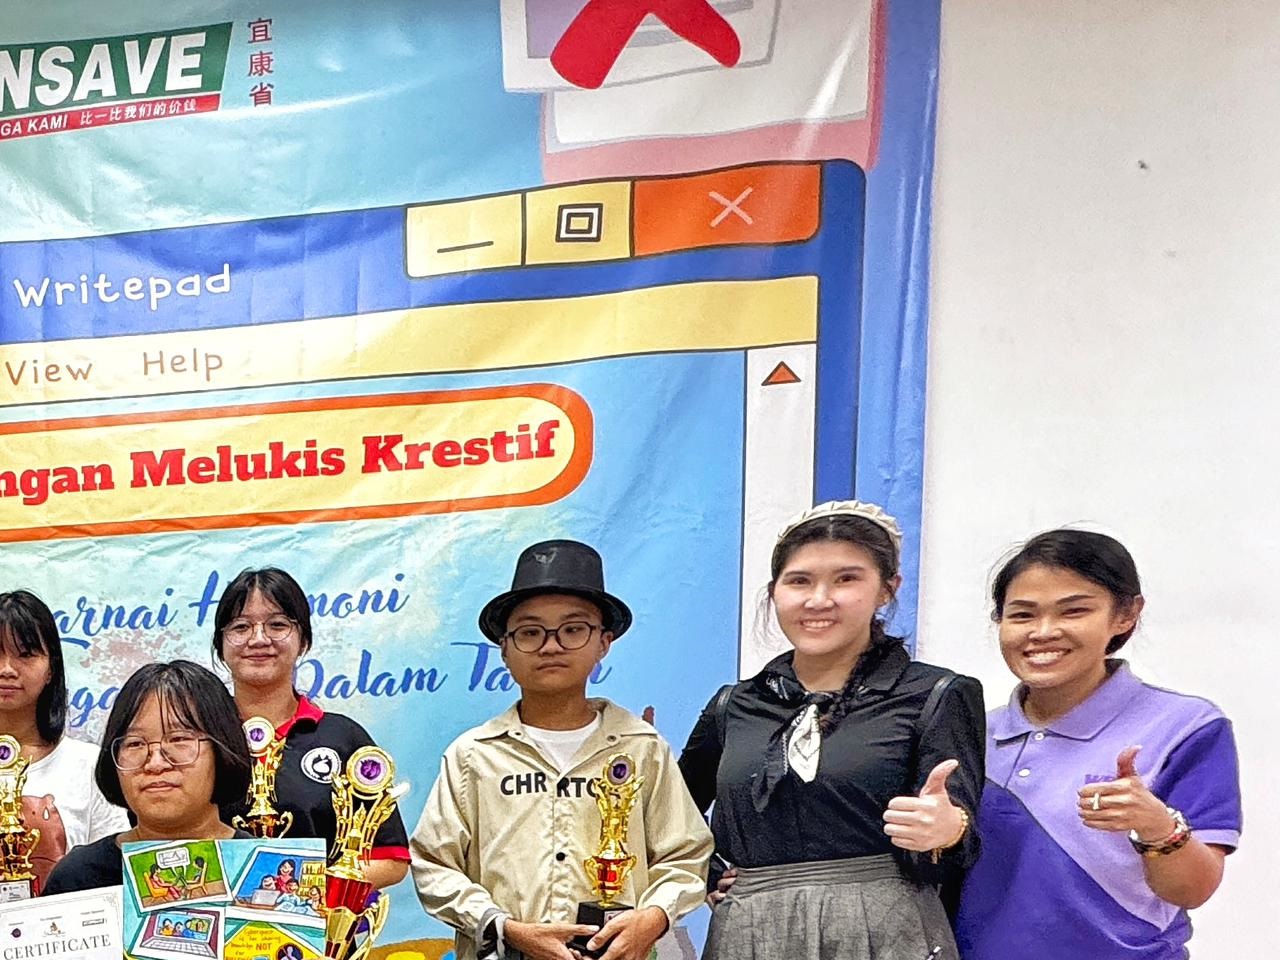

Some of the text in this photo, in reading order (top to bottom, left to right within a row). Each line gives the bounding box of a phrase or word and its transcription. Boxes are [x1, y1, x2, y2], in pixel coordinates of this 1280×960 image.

[247, 17, 275, 108] 宜康省
[27, 115, 69, 134] KAMI
[79, 99, 197, 126] 比一比我们的价钱
[13, 263, 232, 315] Writepad
[5, 357, 93, 387] View
[142, 347, 224, 381] Help
[129, 438, 346, 489] Melukis
[361, 420, 562, 475] Krestif
[3, 934, 112, 960] CERTIFICATE
[255, 942, 272, 951] NOT
